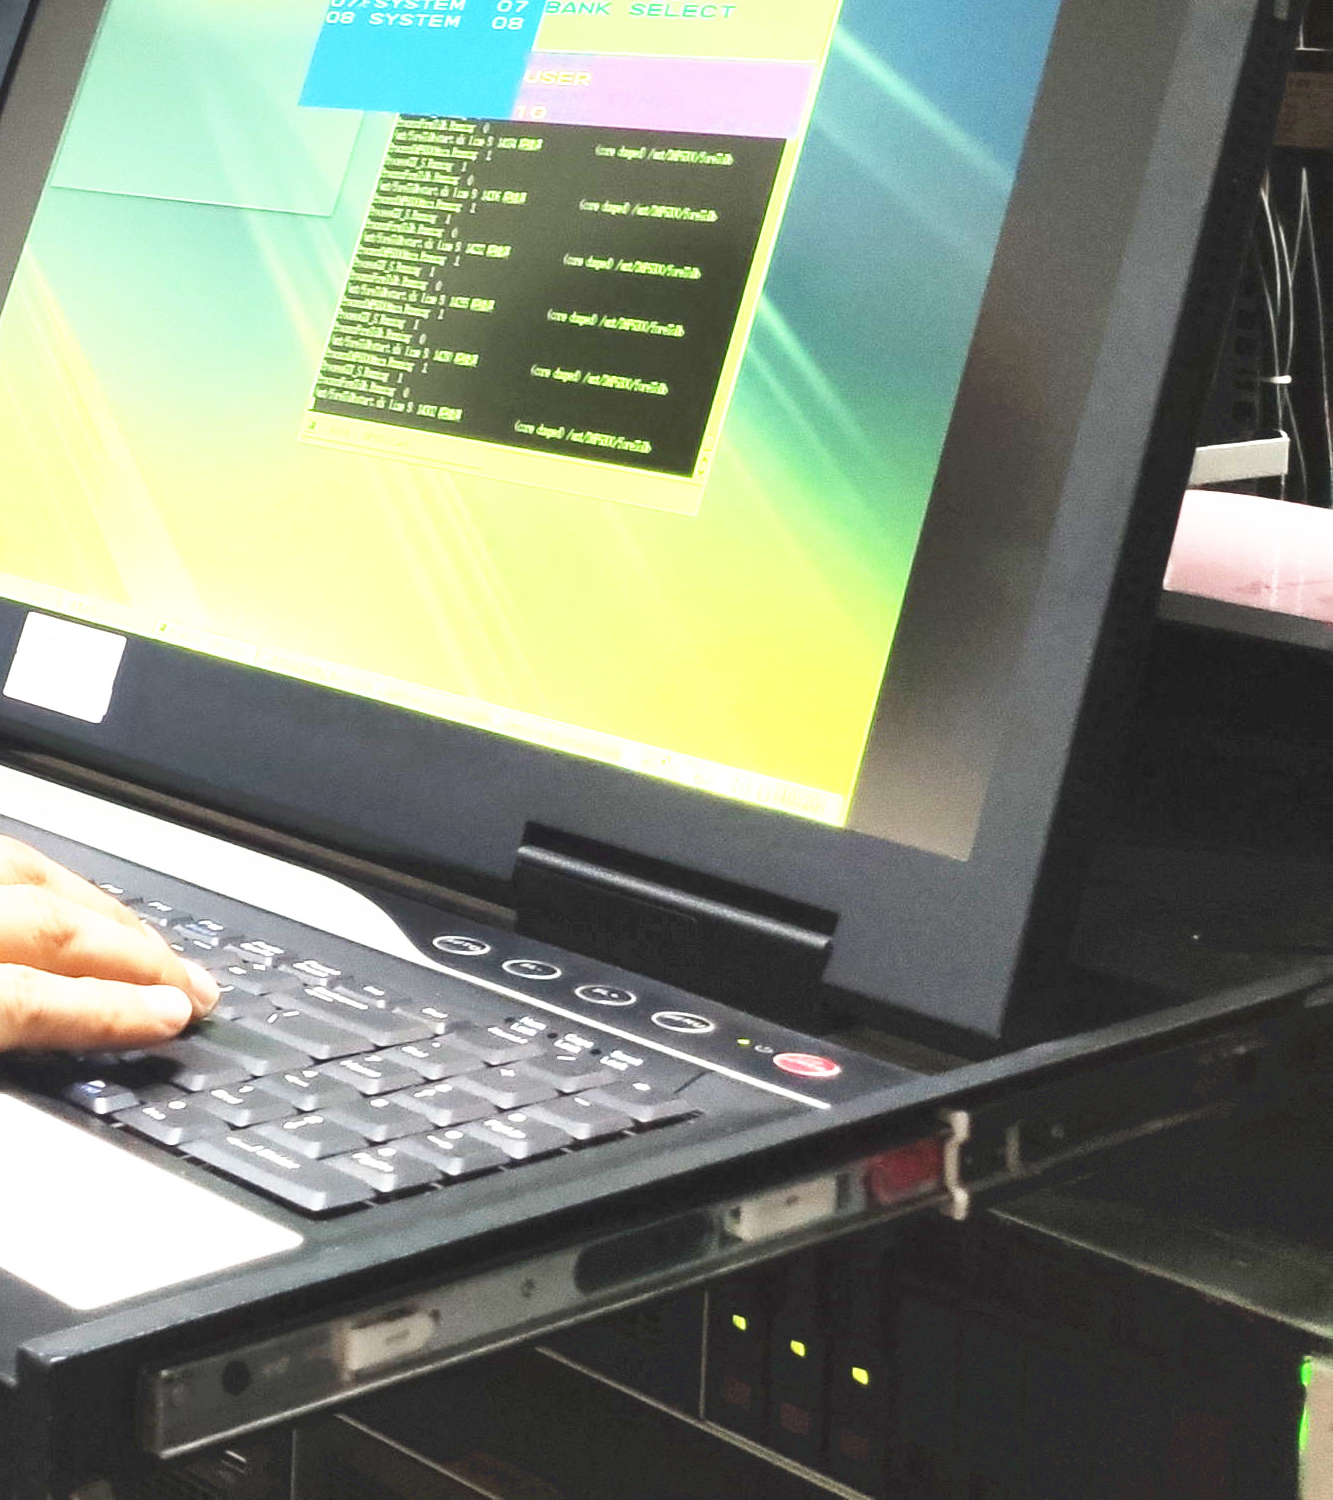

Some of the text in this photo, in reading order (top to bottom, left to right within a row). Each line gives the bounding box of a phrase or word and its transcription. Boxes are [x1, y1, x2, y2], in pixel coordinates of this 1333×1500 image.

[496, 0, 529, 12] 07
[544, 1, 737, 19] BANK SELECT
[325, 11, 525, 30] 08 SYSTEM 08
[523, 69, 592, 87] USER
[516, 105, 548, 120] 10
